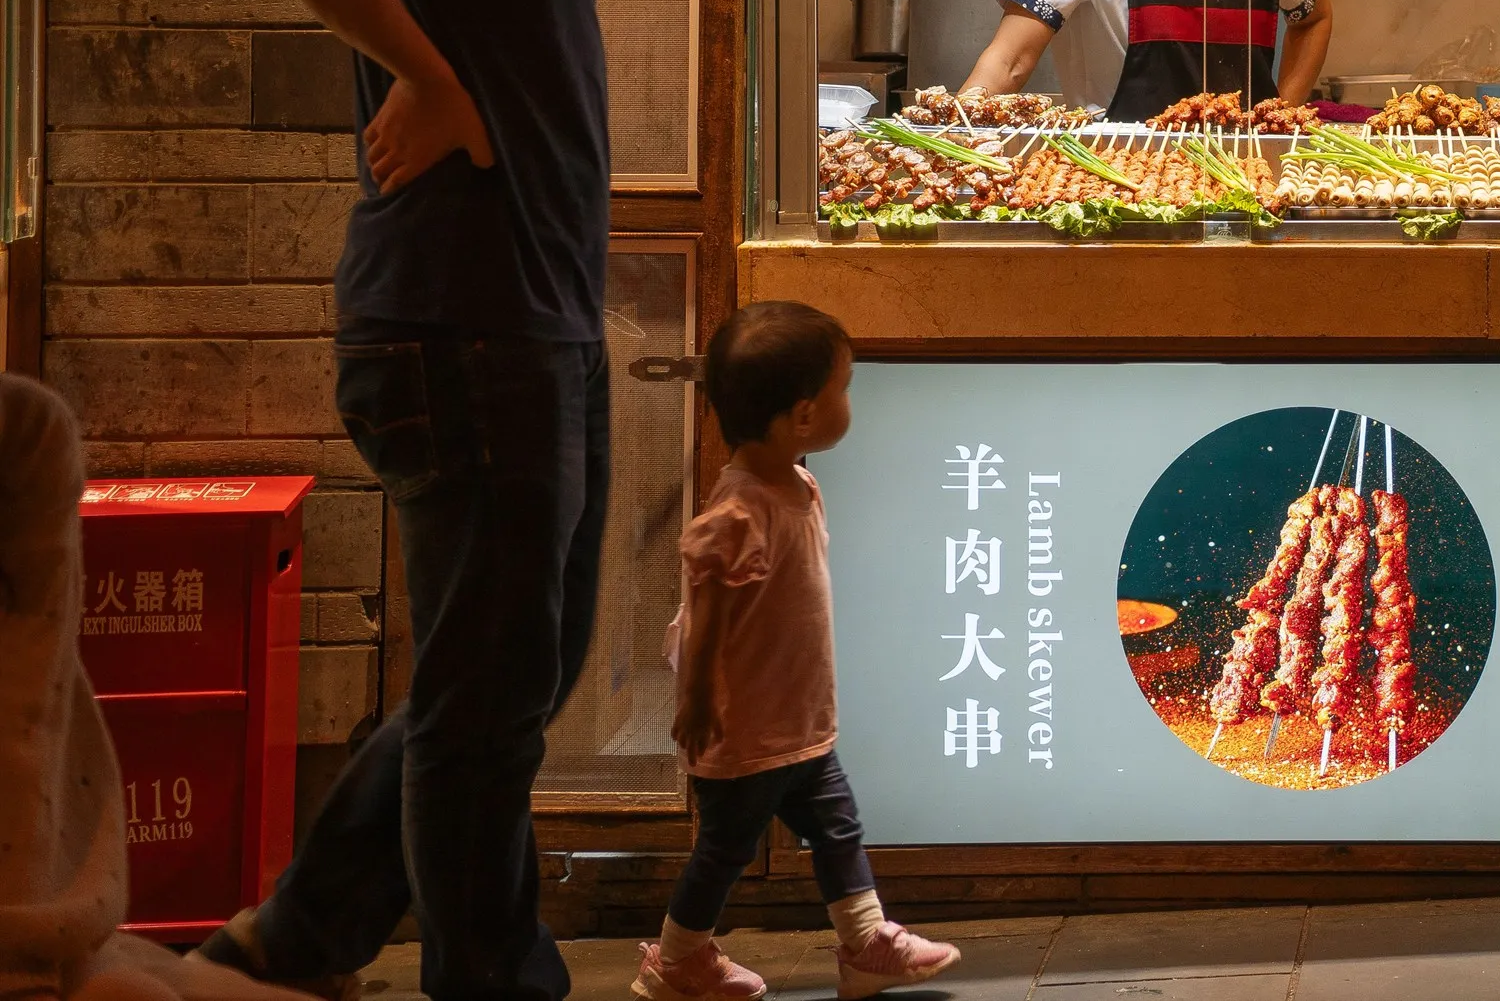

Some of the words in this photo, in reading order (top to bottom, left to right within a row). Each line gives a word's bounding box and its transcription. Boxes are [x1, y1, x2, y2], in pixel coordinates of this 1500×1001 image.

[1028, 472, 1064, 596] Lamb
[81, 568, 204, 613] 火器箱
[178, 614, 203, 632] BOX
[939, 443, 1006, 769] 羊肉大串
[1028, 608, 1064, 770] skewer
[126, 777, 192, 823] 119
